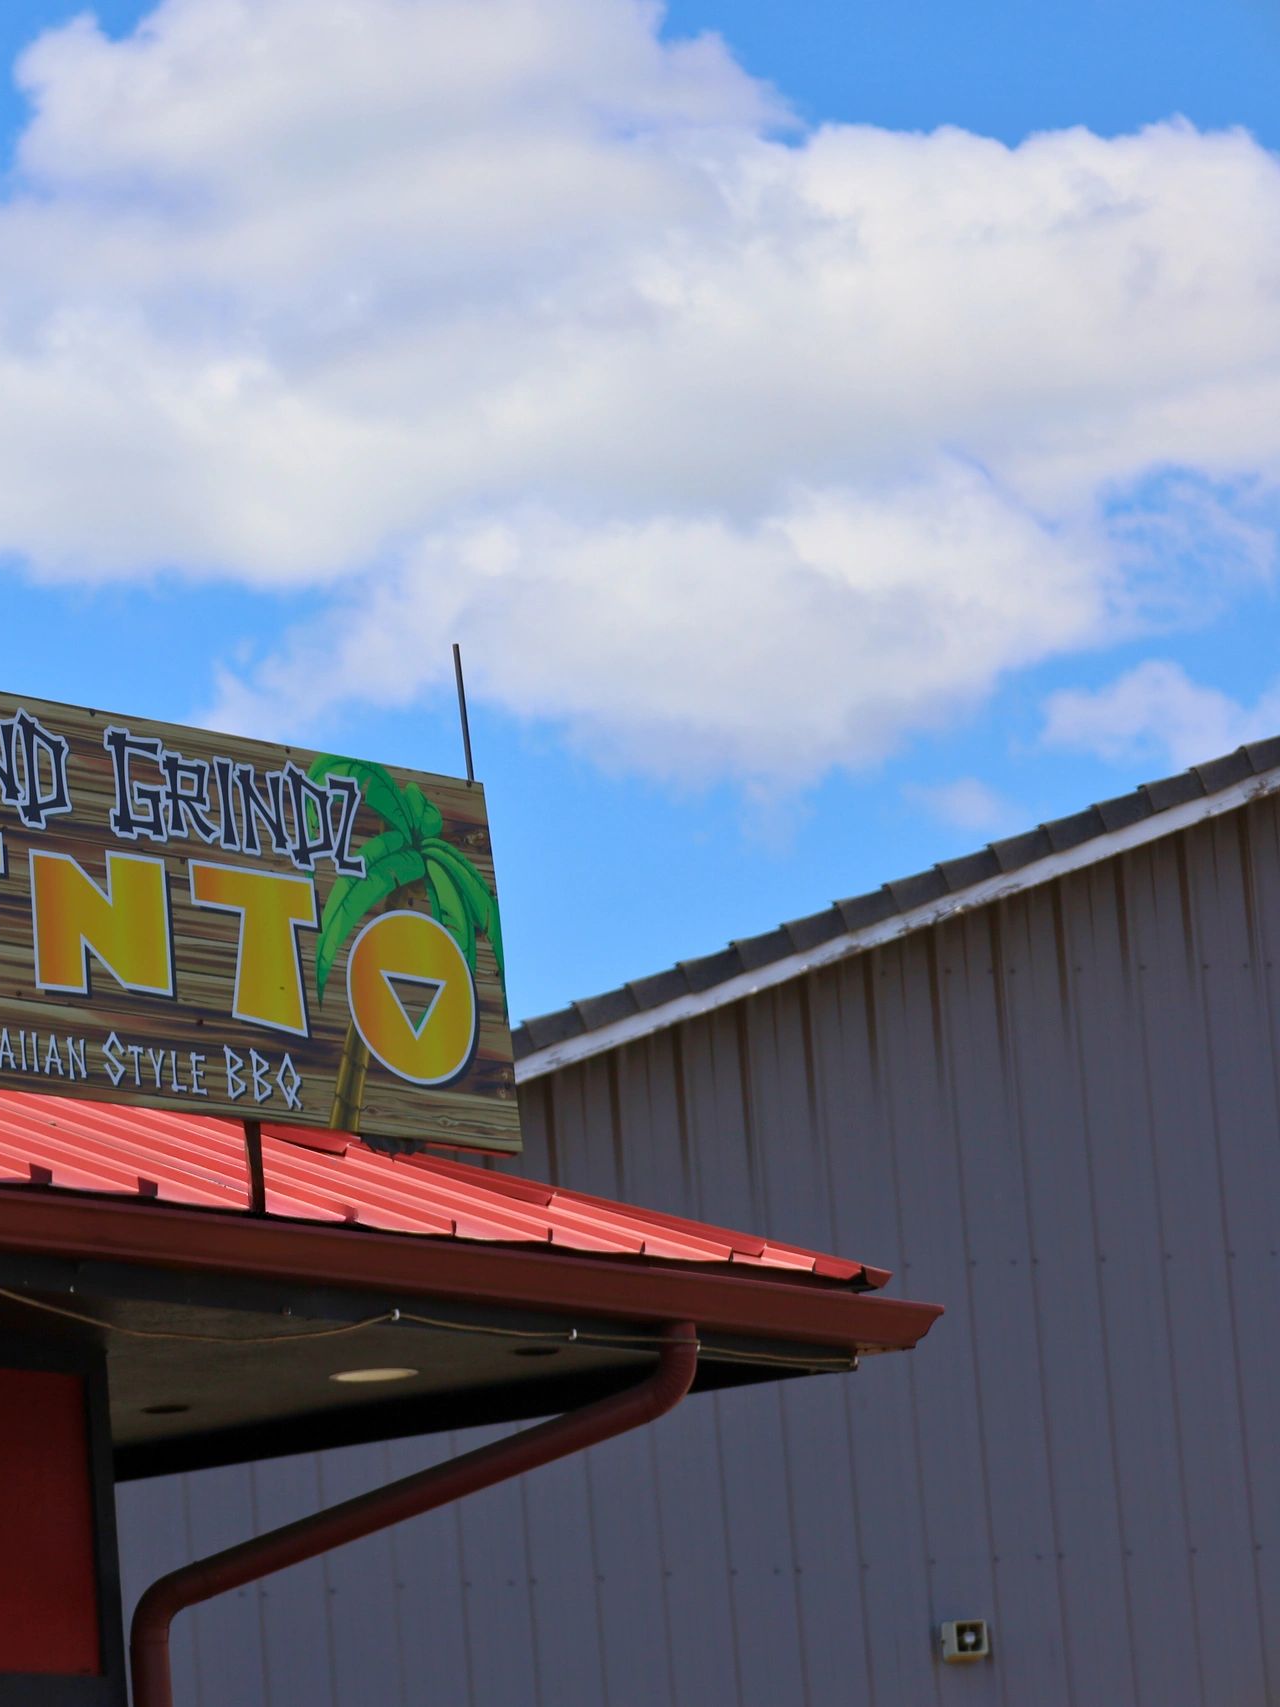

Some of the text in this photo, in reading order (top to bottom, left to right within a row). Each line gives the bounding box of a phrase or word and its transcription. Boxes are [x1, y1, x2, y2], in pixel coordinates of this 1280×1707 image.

[104, 725, 366, 878] GRINDZ
[101, 1030, 208, 1096] STYLE
[223, 1044, 304, 1111] BBQ
